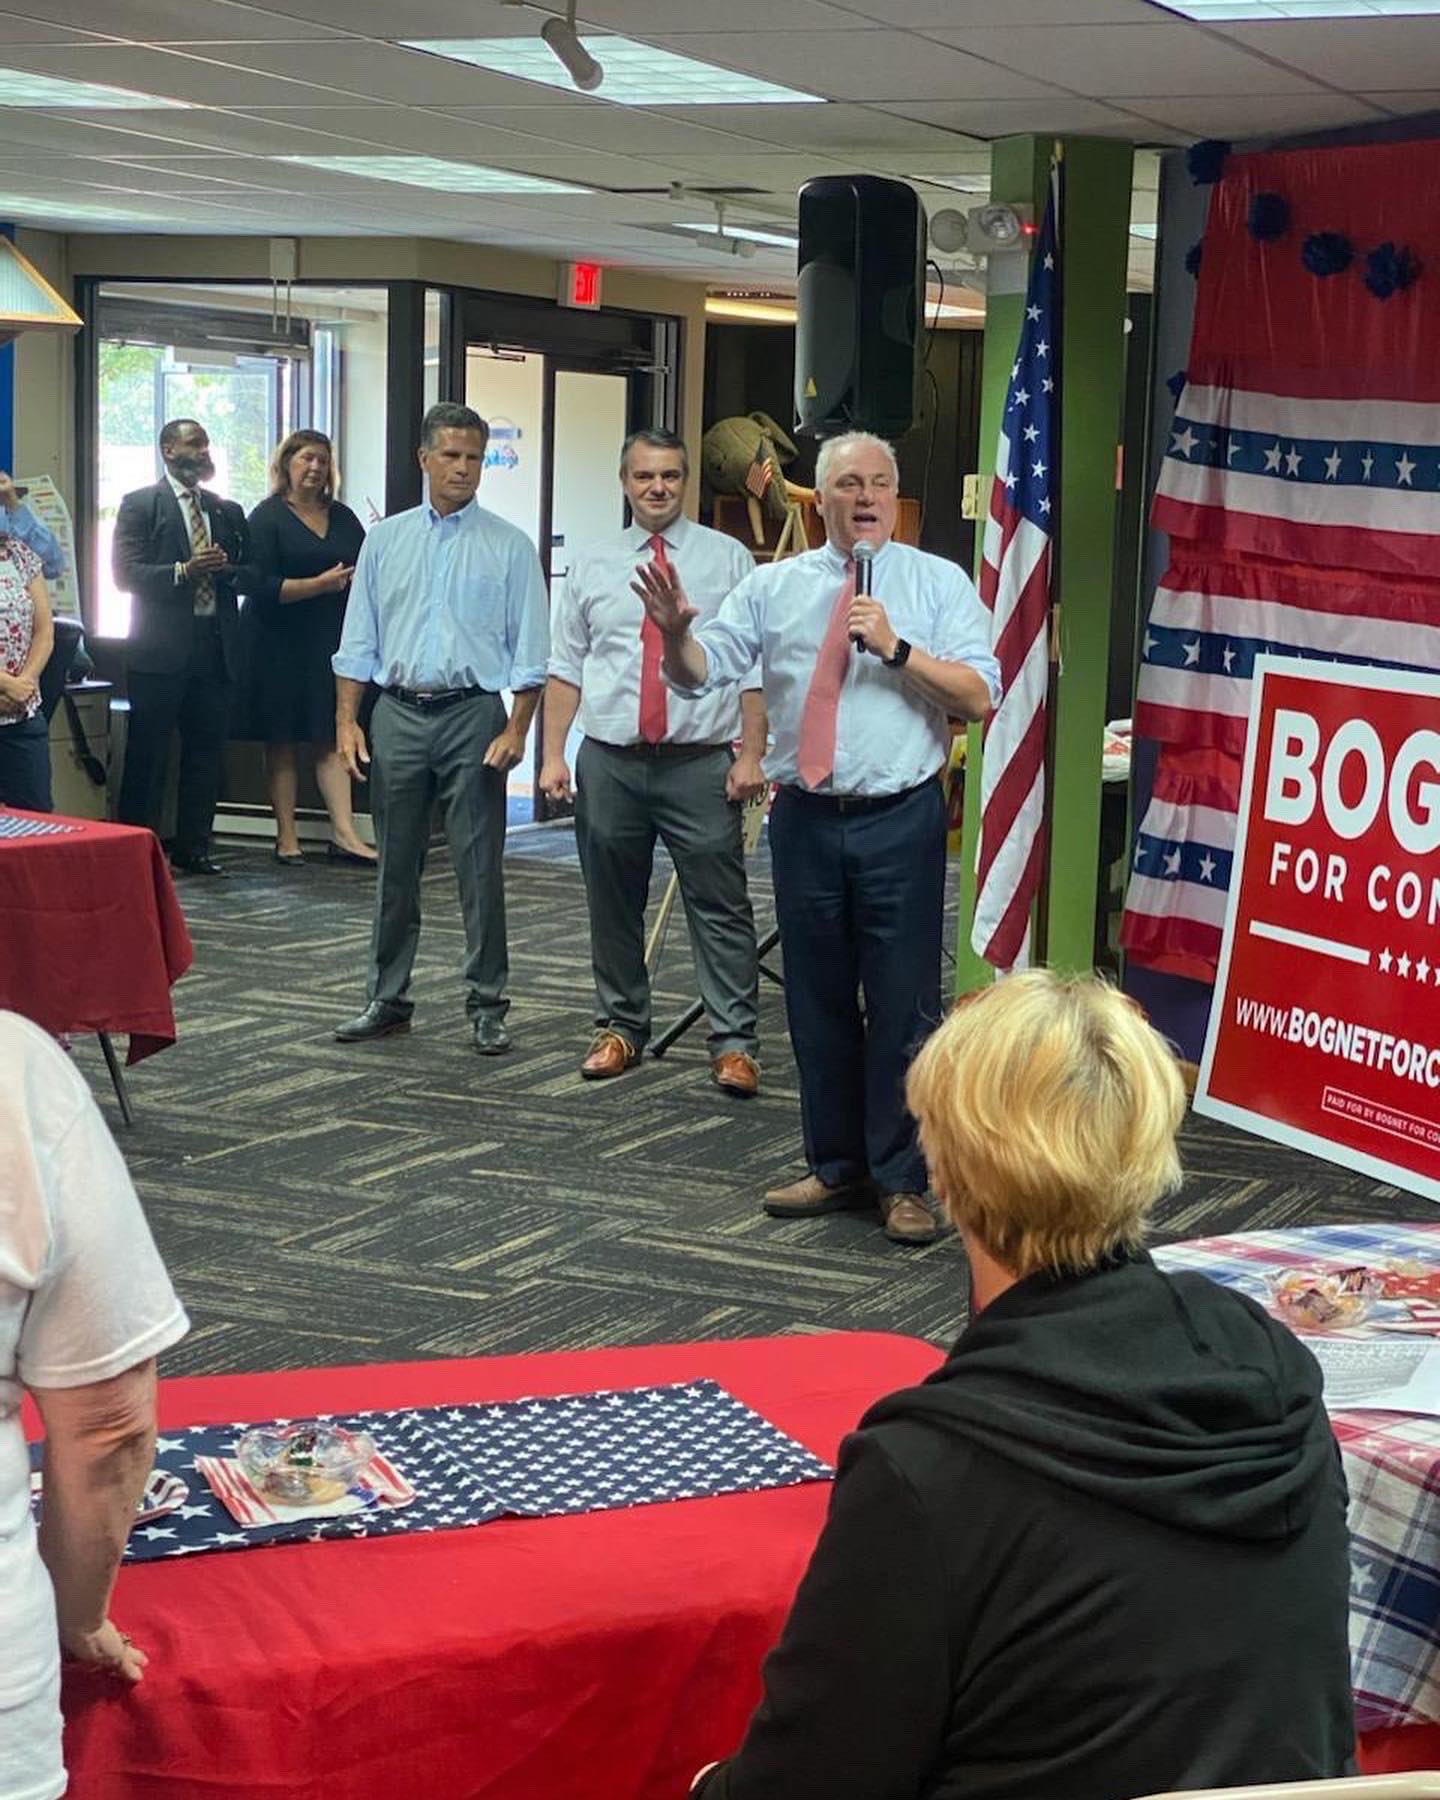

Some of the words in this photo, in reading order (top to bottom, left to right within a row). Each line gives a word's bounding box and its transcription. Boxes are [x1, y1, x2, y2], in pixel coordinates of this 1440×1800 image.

[1264, 708, 1440, 855] BOG
[1269, 842, 1347, 902] FOR
[1236, 997, 1440, 1088] WWW.BOGNETFORC
[1327, 1094, 1345, 1108] PAID
[1346, 1101, 1362, 1115] FOR
[1363, 1107, 1375, 1118] BY
[1375, 1111, 1407, 1129] BOGNET
[1408, 1123, 1426, 1137] FOR
